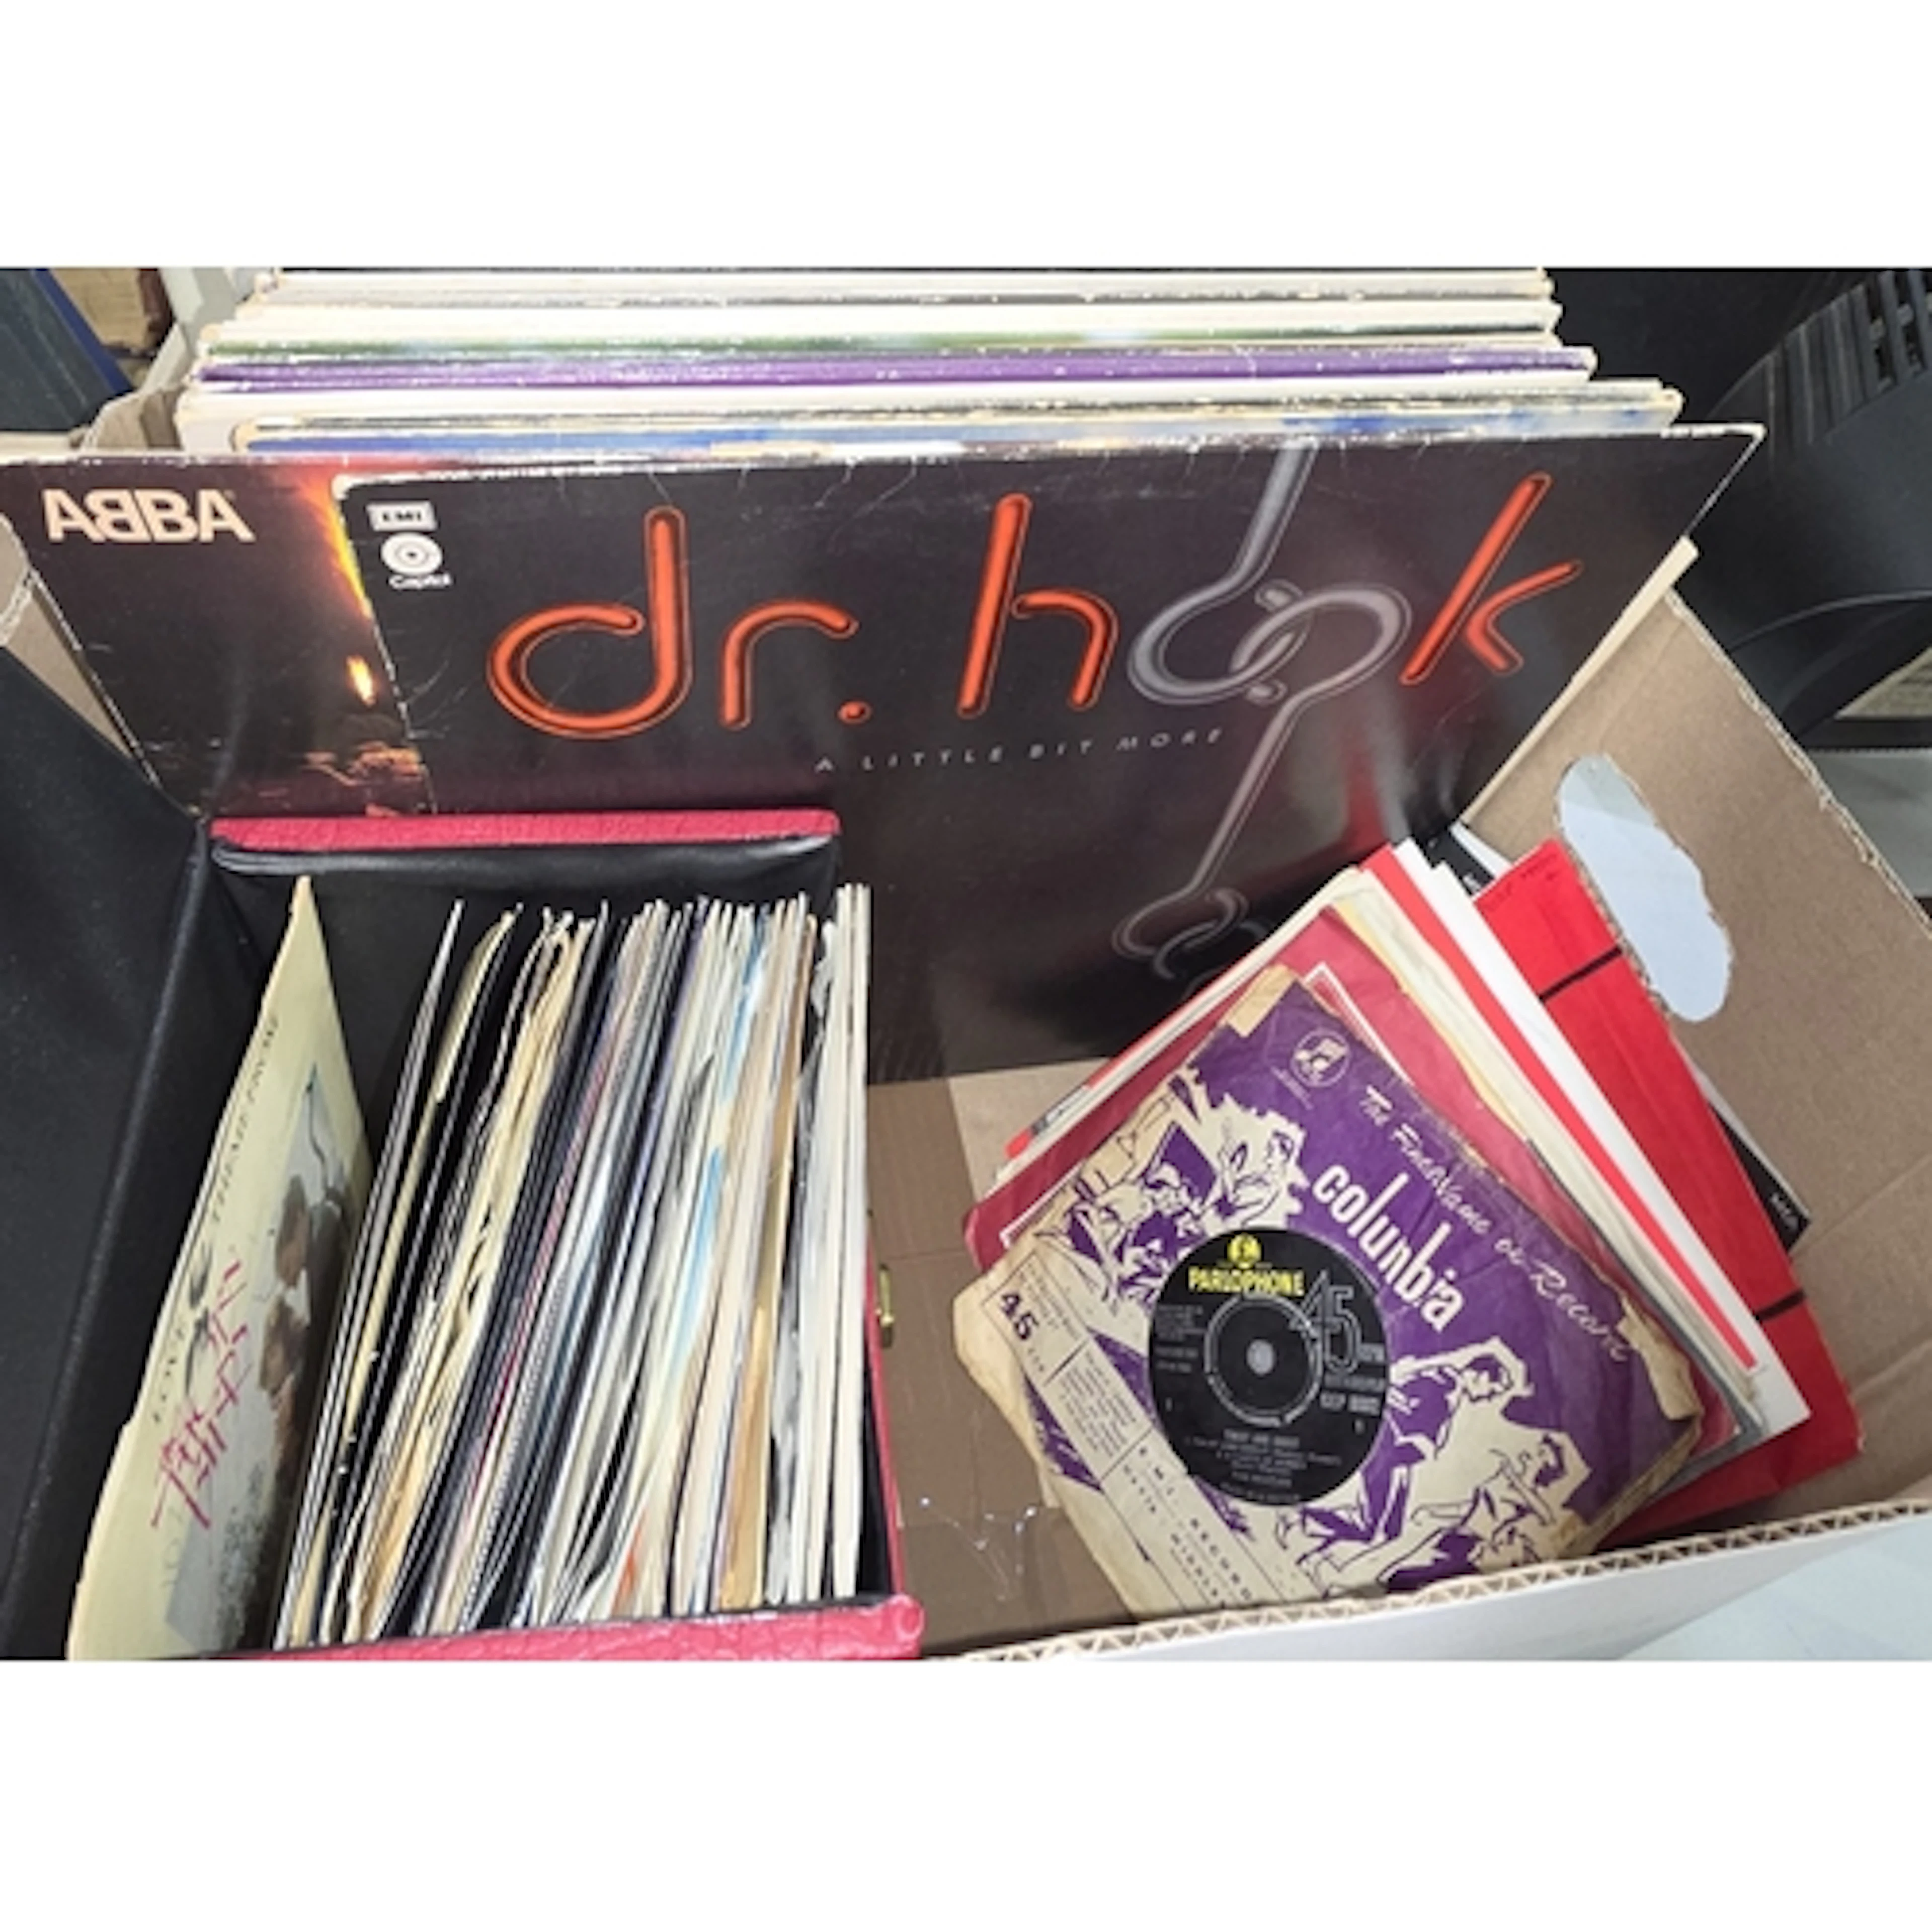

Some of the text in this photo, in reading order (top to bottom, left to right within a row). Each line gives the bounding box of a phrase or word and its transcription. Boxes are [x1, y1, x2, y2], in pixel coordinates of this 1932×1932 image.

[42, 488, 256, 543] ABBA
[486, 468, 1584, 740] dr. hook
[815, 726, 1223, 773] A LITTLE BIT MORE
[1000, 1292, 1039, 1341] 45
